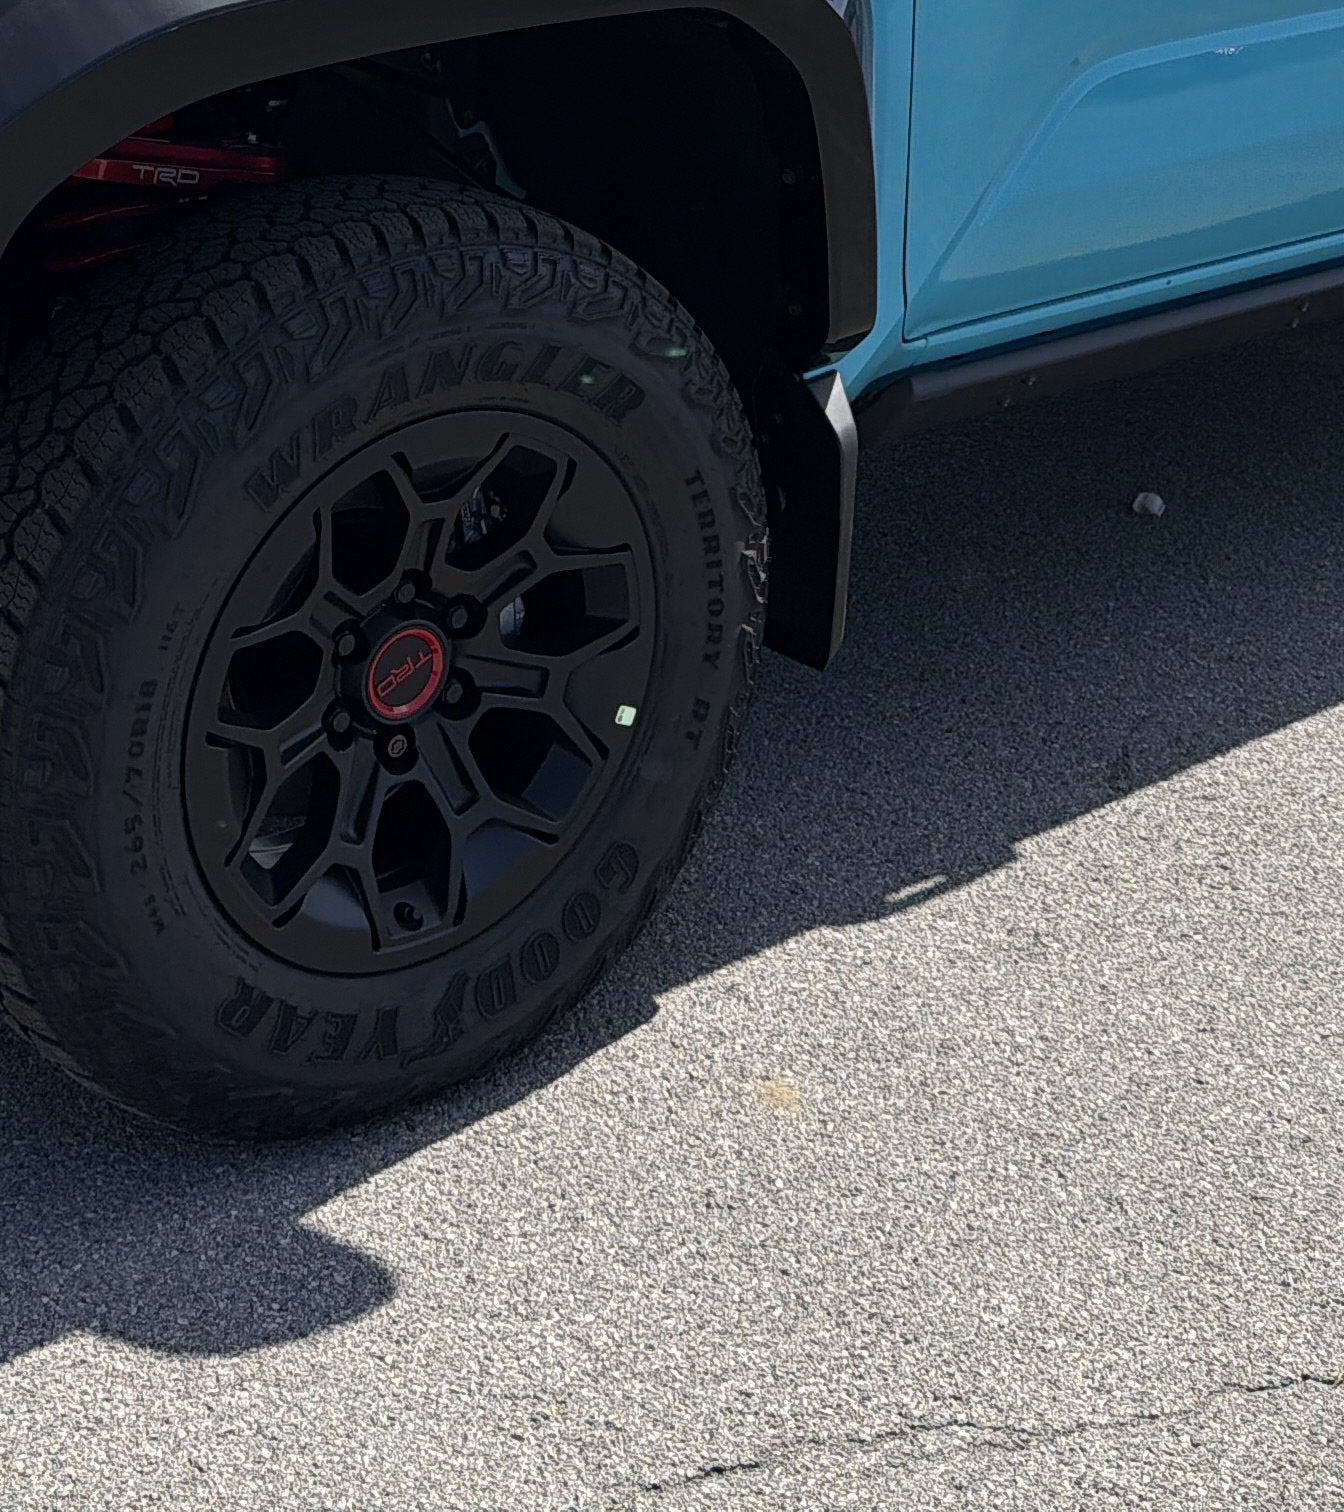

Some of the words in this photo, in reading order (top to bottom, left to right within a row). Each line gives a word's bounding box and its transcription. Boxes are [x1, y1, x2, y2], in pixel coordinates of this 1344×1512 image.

[132, 164, 200, 188] TRD
[243, 339, 647, 513] WRANGLER
[684, 469, 725, 670] TERRITORY
[376, 649, 433, 698] TRD
[122, 678, 159, 876] 265/70R18
